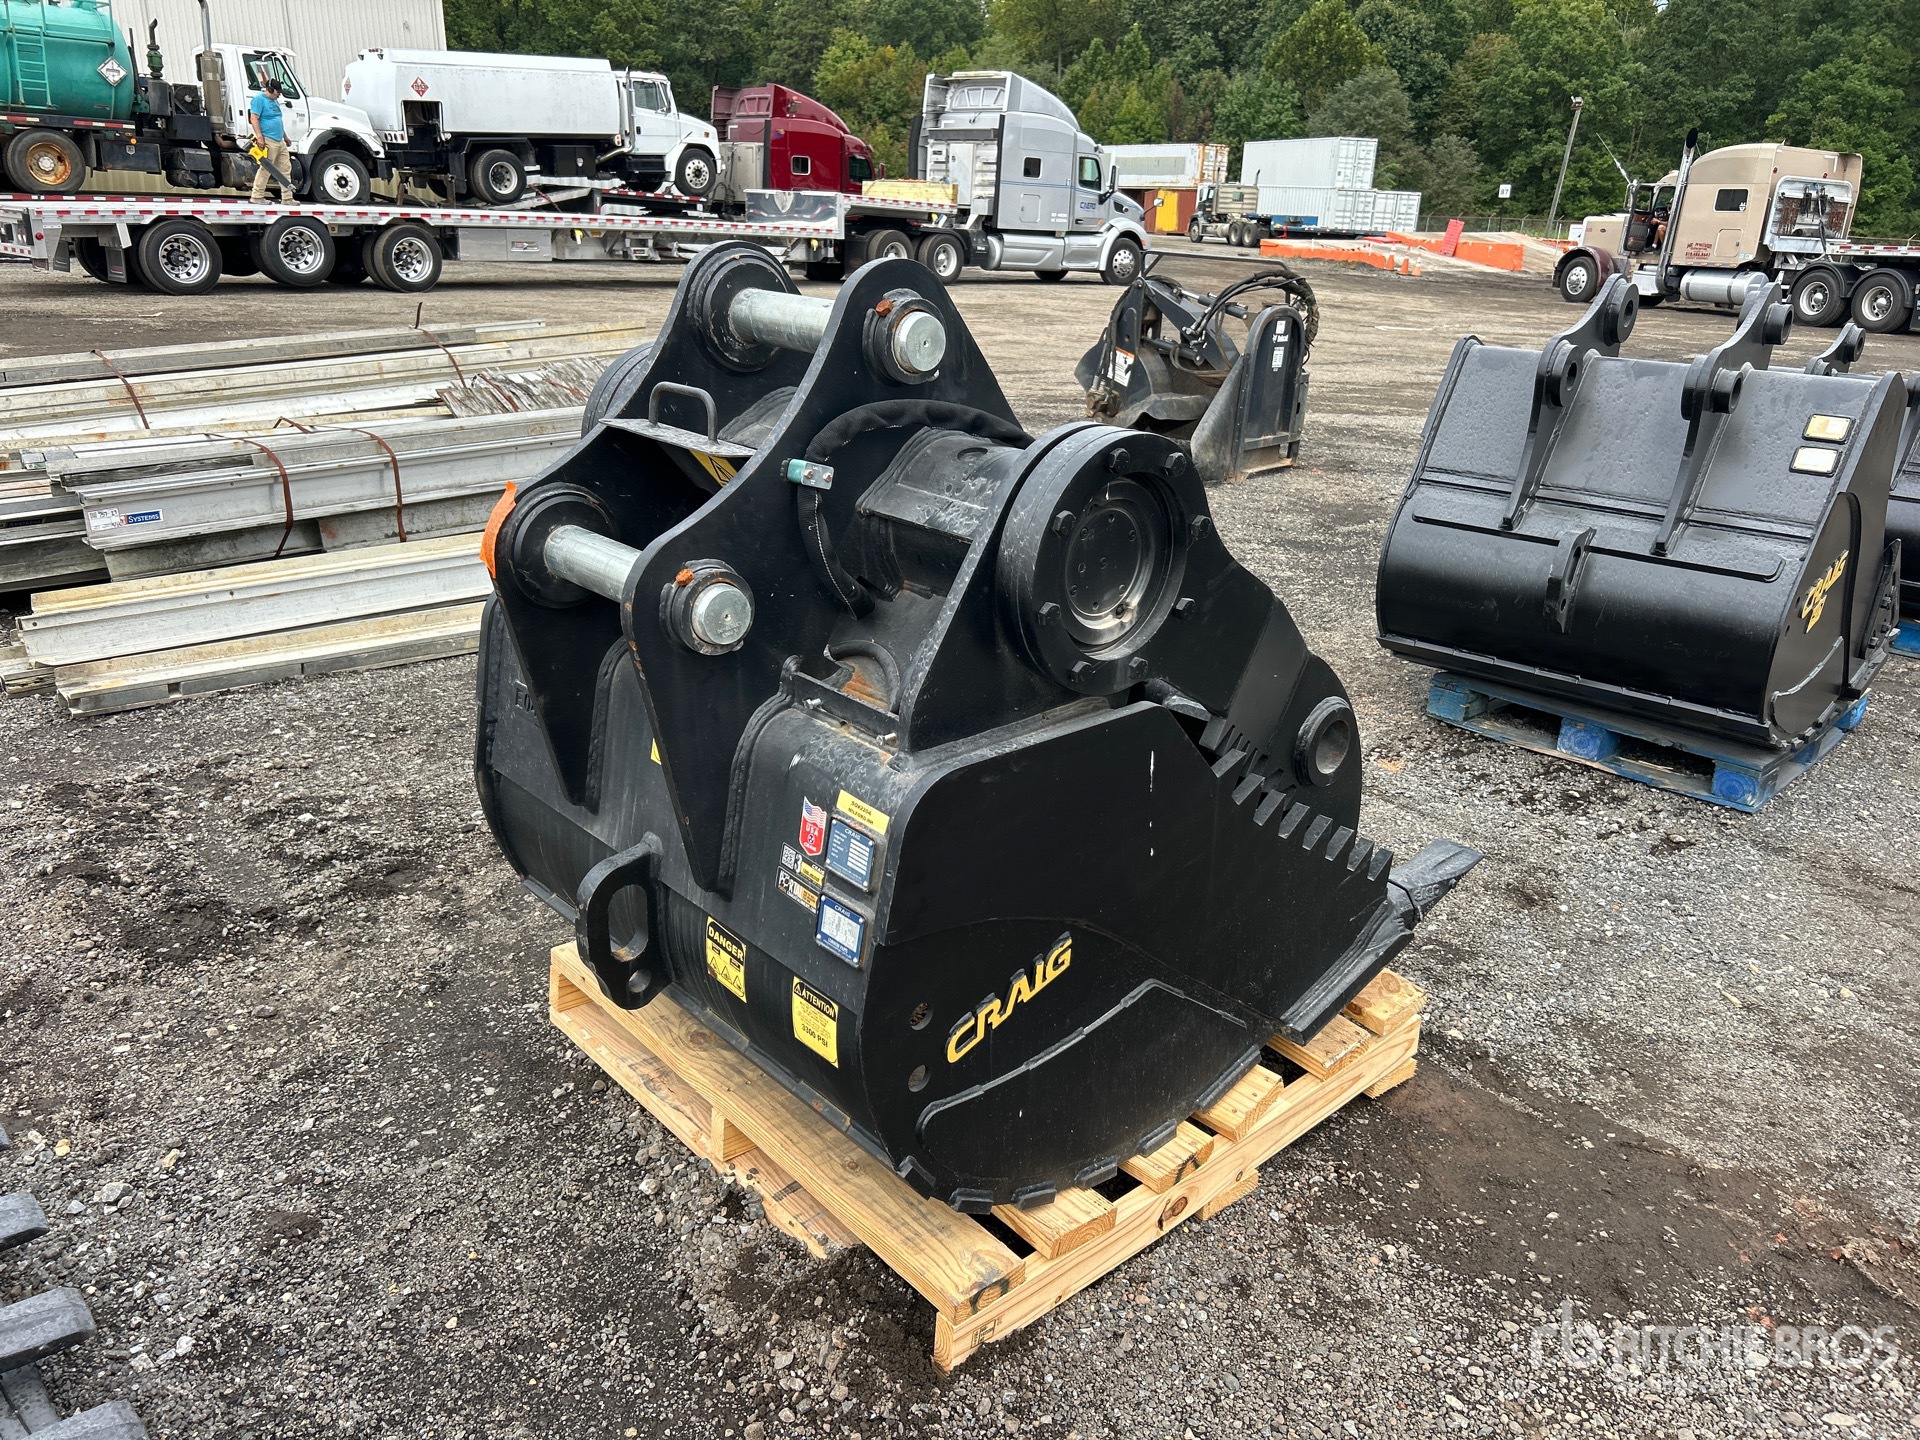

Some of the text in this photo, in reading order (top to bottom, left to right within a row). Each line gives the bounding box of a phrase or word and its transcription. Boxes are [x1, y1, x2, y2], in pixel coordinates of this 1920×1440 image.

[805, 825, 819, 837] USA
[844, 828, 861, 840] CRAIG
[811, 864, 825, 875] CRAIG
[834, 904, 851, 917] CRAIG
[708, 926, 744, 961] DANGER
[802, 987, 835, 1018] ATTENTION
[946, 935, 1072, 1063] CRAIG
[817, 1034, 828, 1048] PSI
